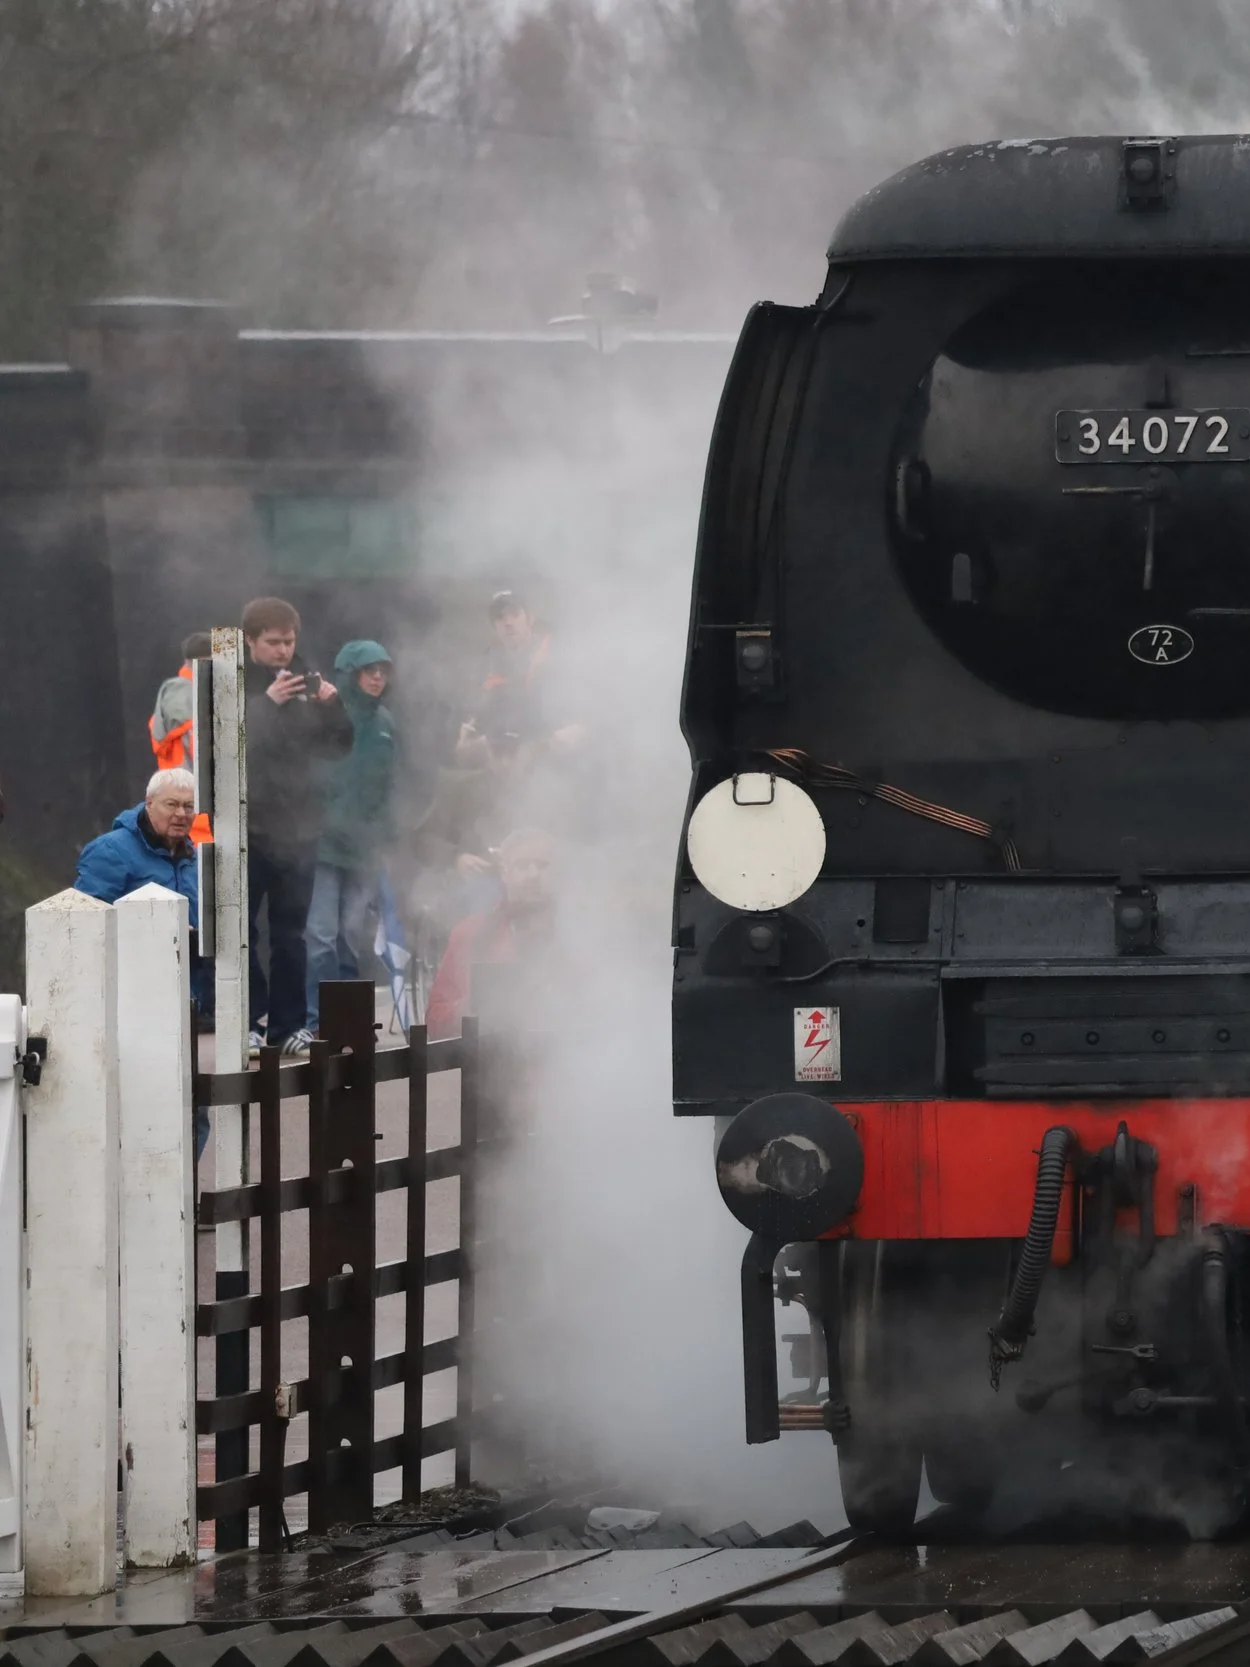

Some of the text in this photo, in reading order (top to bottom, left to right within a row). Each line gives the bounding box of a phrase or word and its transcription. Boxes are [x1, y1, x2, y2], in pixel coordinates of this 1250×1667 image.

[1078, 416, 1229, 454] 34072
[1148, 630, 1173, 646] 72
[1155, 647, 1169, 660] A
